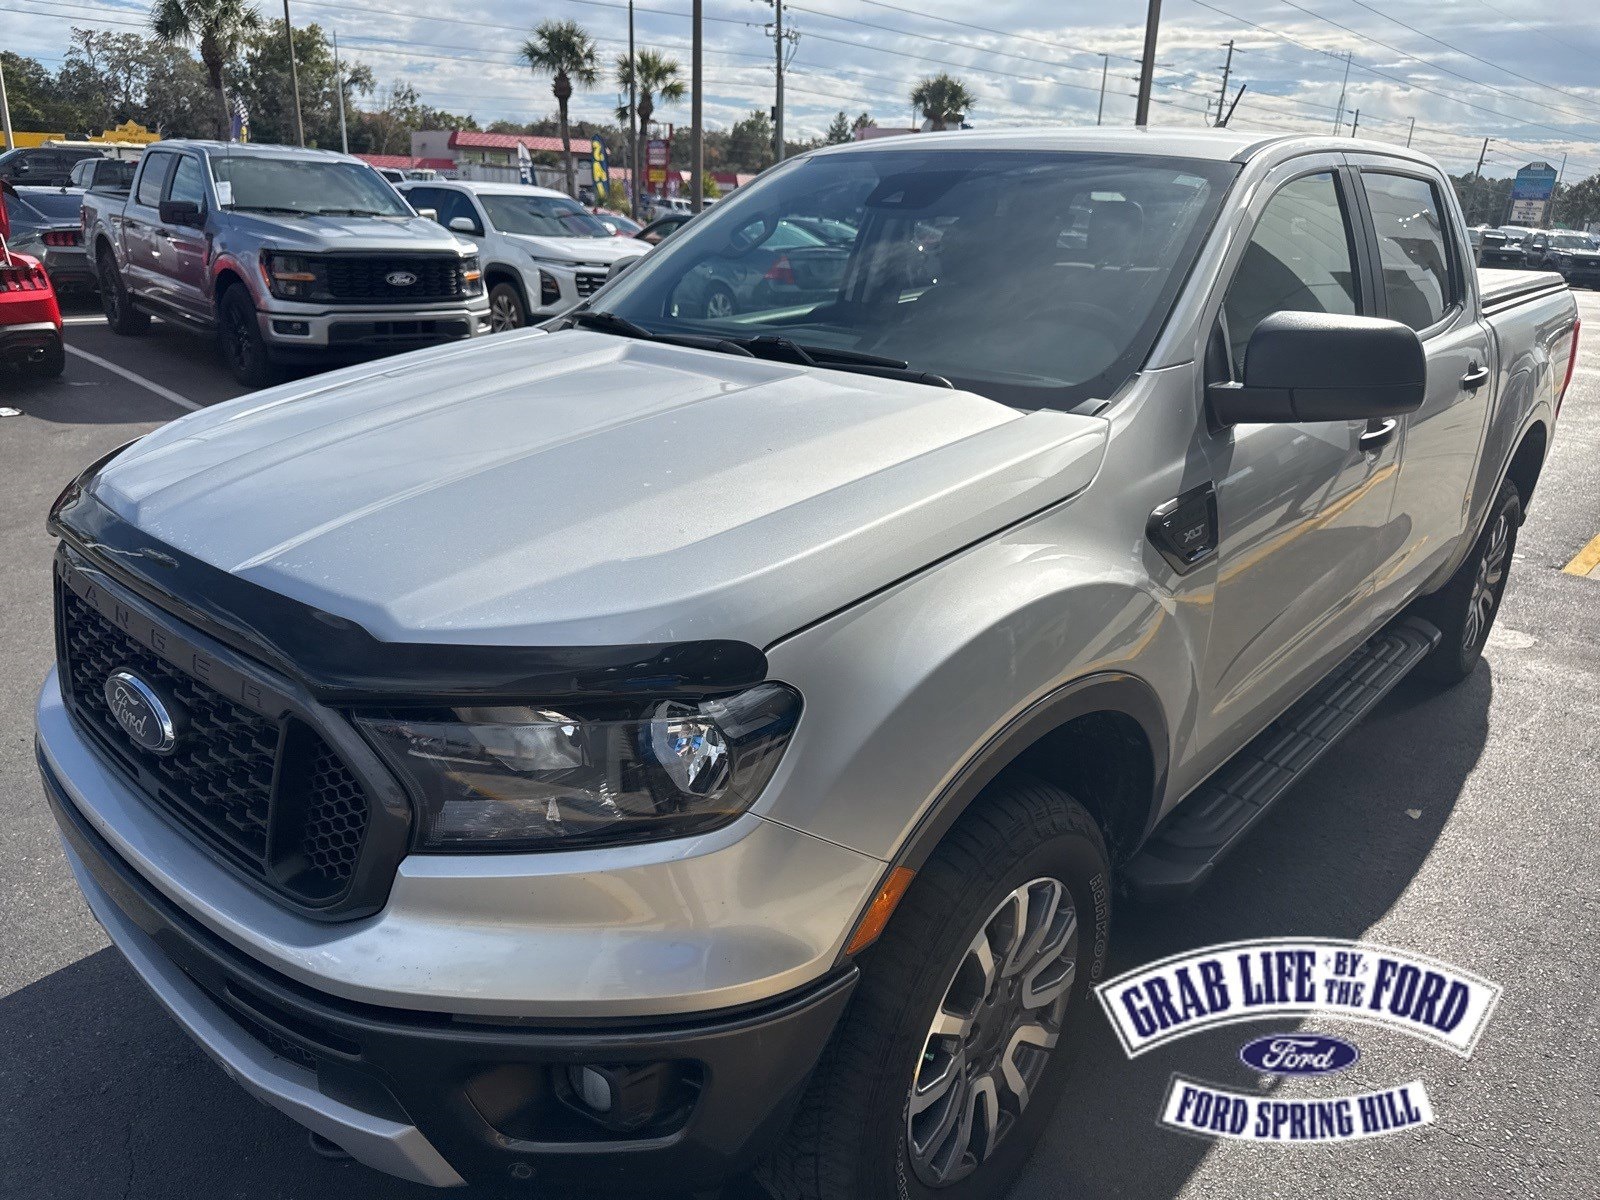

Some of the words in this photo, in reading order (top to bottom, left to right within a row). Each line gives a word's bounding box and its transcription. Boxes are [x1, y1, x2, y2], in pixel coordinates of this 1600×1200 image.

[1183, 523, 1205, 543] XLT
[62, 562, 264, 708] RANGER
[112, 685, 147, 738] Ford
